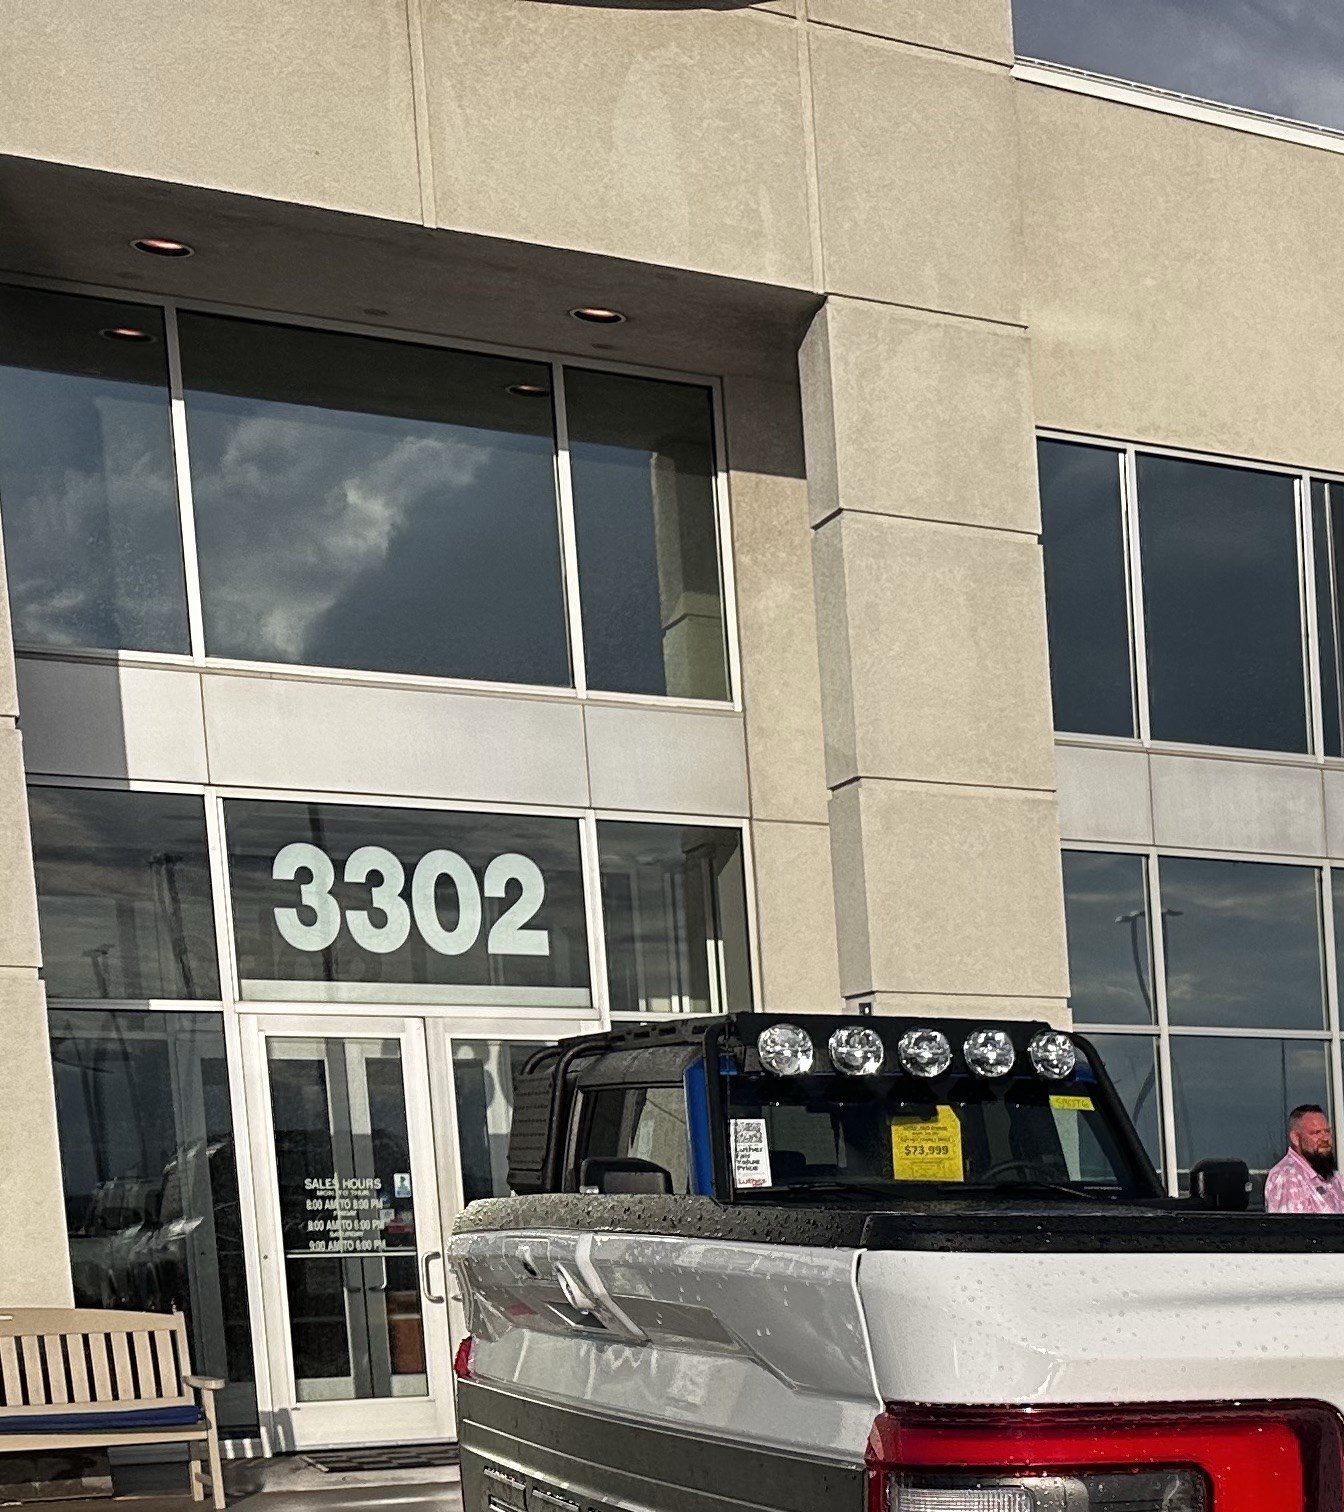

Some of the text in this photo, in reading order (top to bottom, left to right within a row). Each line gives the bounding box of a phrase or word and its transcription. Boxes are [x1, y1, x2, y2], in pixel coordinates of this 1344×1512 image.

[272, 842, 550, 956] 3302
[904, 1145, 949, 1156] $73,999
[304, 1178, 382, 1189] SALES HOURS
[370, 1198, 383, 1210] PM
